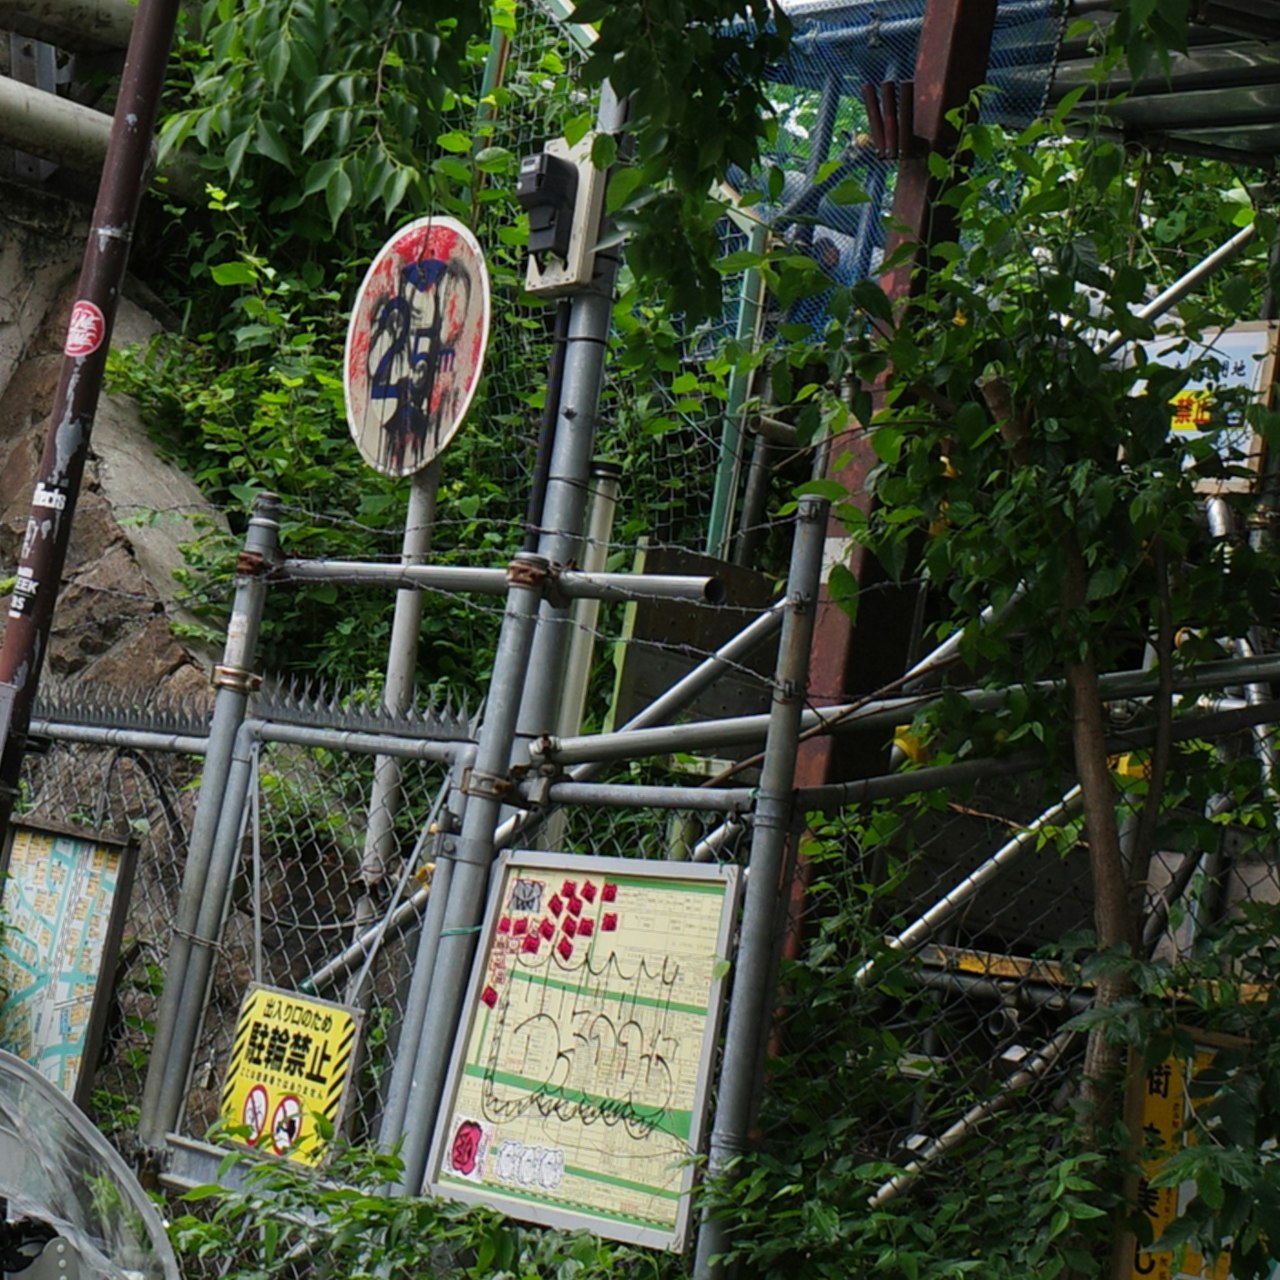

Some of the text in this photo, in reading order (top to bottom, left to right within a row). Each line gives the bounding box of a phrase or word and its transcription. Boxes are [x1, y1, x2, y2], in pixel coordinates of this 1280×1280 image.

[263, 998, 333, 1034] 出入り口のため
[245, 1021, 333, 1085] 駐輪禁止
